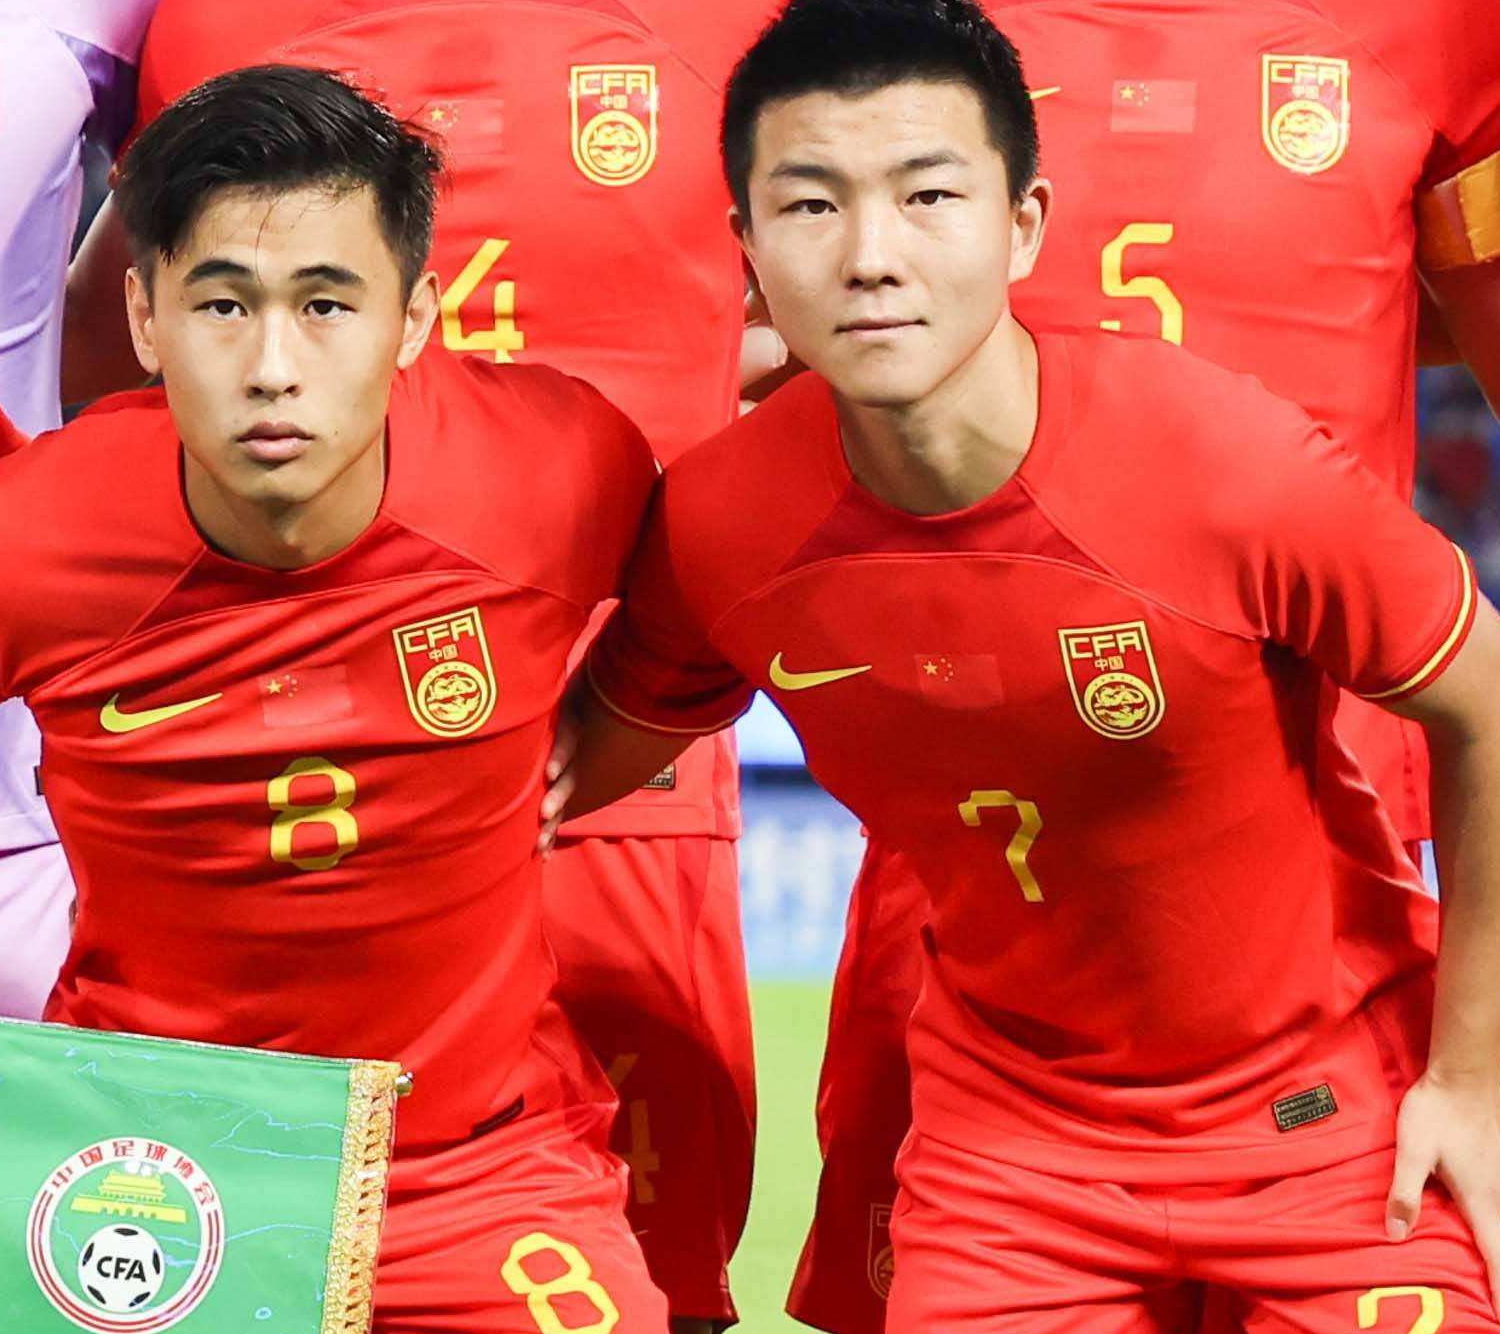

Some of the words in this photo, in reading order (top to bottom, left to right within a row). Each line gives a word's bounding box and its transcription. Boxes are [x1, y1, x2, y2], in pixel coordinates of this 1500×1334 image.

[579, 73, 647, 95] CFA
[1271, 62, 1341, 87] CFA
[1100, 223, 1183, 344] 5
[439, 239, 525, 363] 4
[402, 617, 476, 653] CFA
[1067, 632, 1143, 659] CFA
[428, 644, 460, 662] 中国
[1094, 656, 1124, 672] 中国
[266, 757, 359, 869] 8
[957, 789, 1044, 903] 7
[51, 1139, 216, 1205] 中国足球协会
[96, 1255, 147, 1282] CFA
